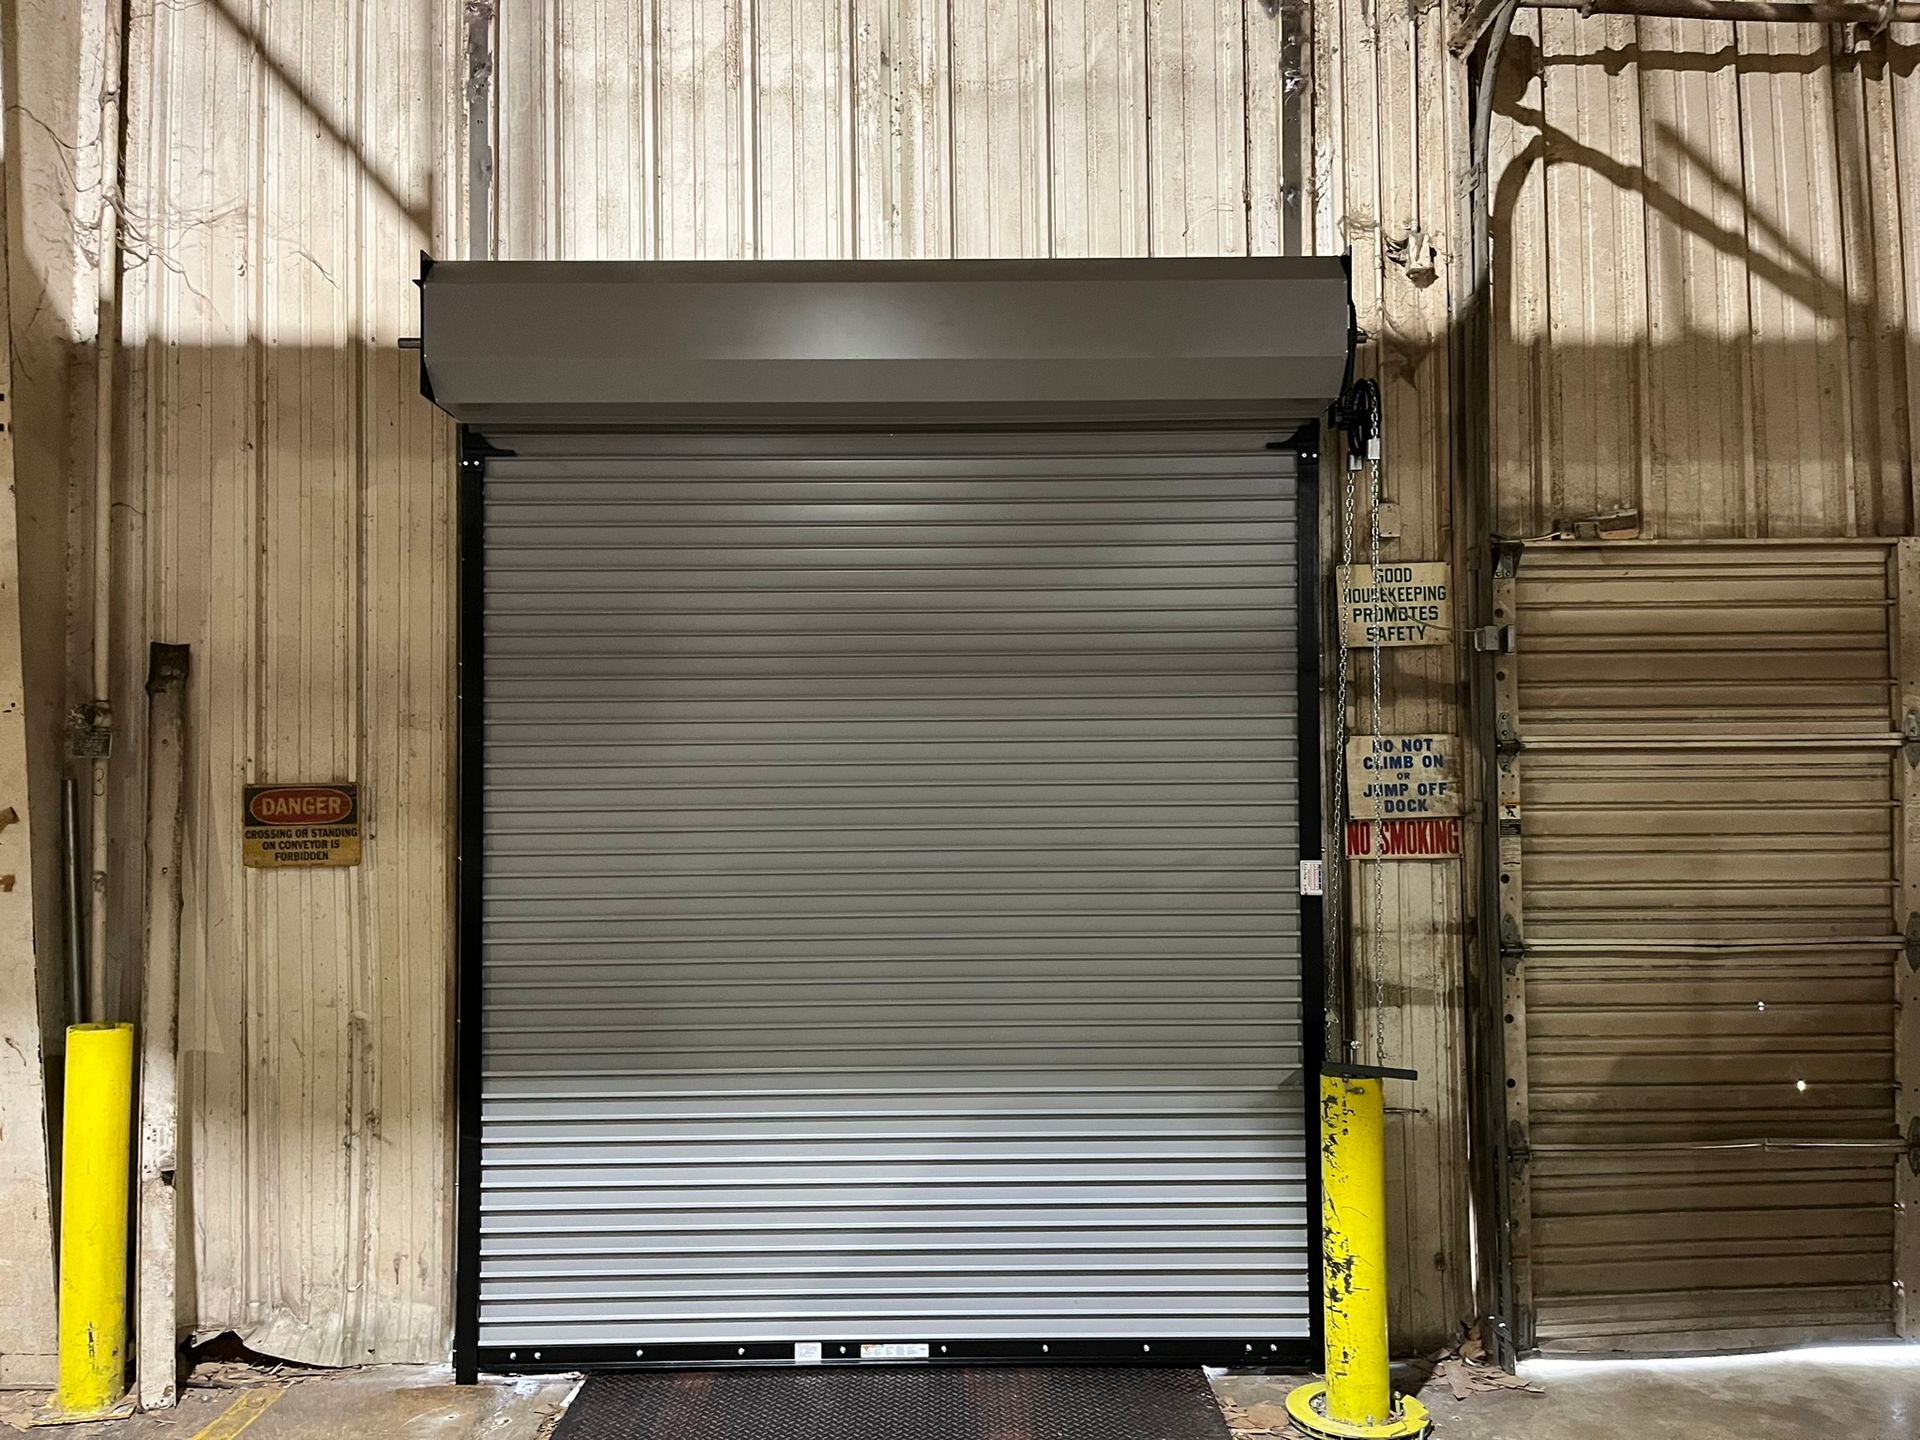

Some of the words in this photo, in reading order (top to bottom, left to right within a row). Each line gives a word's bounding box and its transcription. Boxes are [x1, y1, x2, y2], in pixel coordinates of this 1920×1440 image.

[1373, 568, 1412, 583] GOOD
[1353, 606, 1439, 623] PROMOTES
[1366, 625, 1427, 642] SAFETY
[1401, 738, 1434, 753] NOT
[1422, 754, 1444, 768] ON
[1396, 772, 1410, 780] OR
[1363, 783, 1409, 798] JUMP
[1417, 782, 1447, 796] OFF
[261, 796, 341, 816] DANGER
[1384, 799, 1429, 813] DOCK
[245, 829, 293, 840] CROSSING
[295, 828, 308, 839] OR
[311, 827, 358, 838] STANDING
[1347, 821, 1371, 855] NO
[1380, 820, 1460, 855] SMOKING
[262, 841, 276, 850] ON
[278, 840, 328, 850] CONVEYOR
[331, 839, 340, 849] IS
[275, 851, 329, 861] FORBIDDEN
